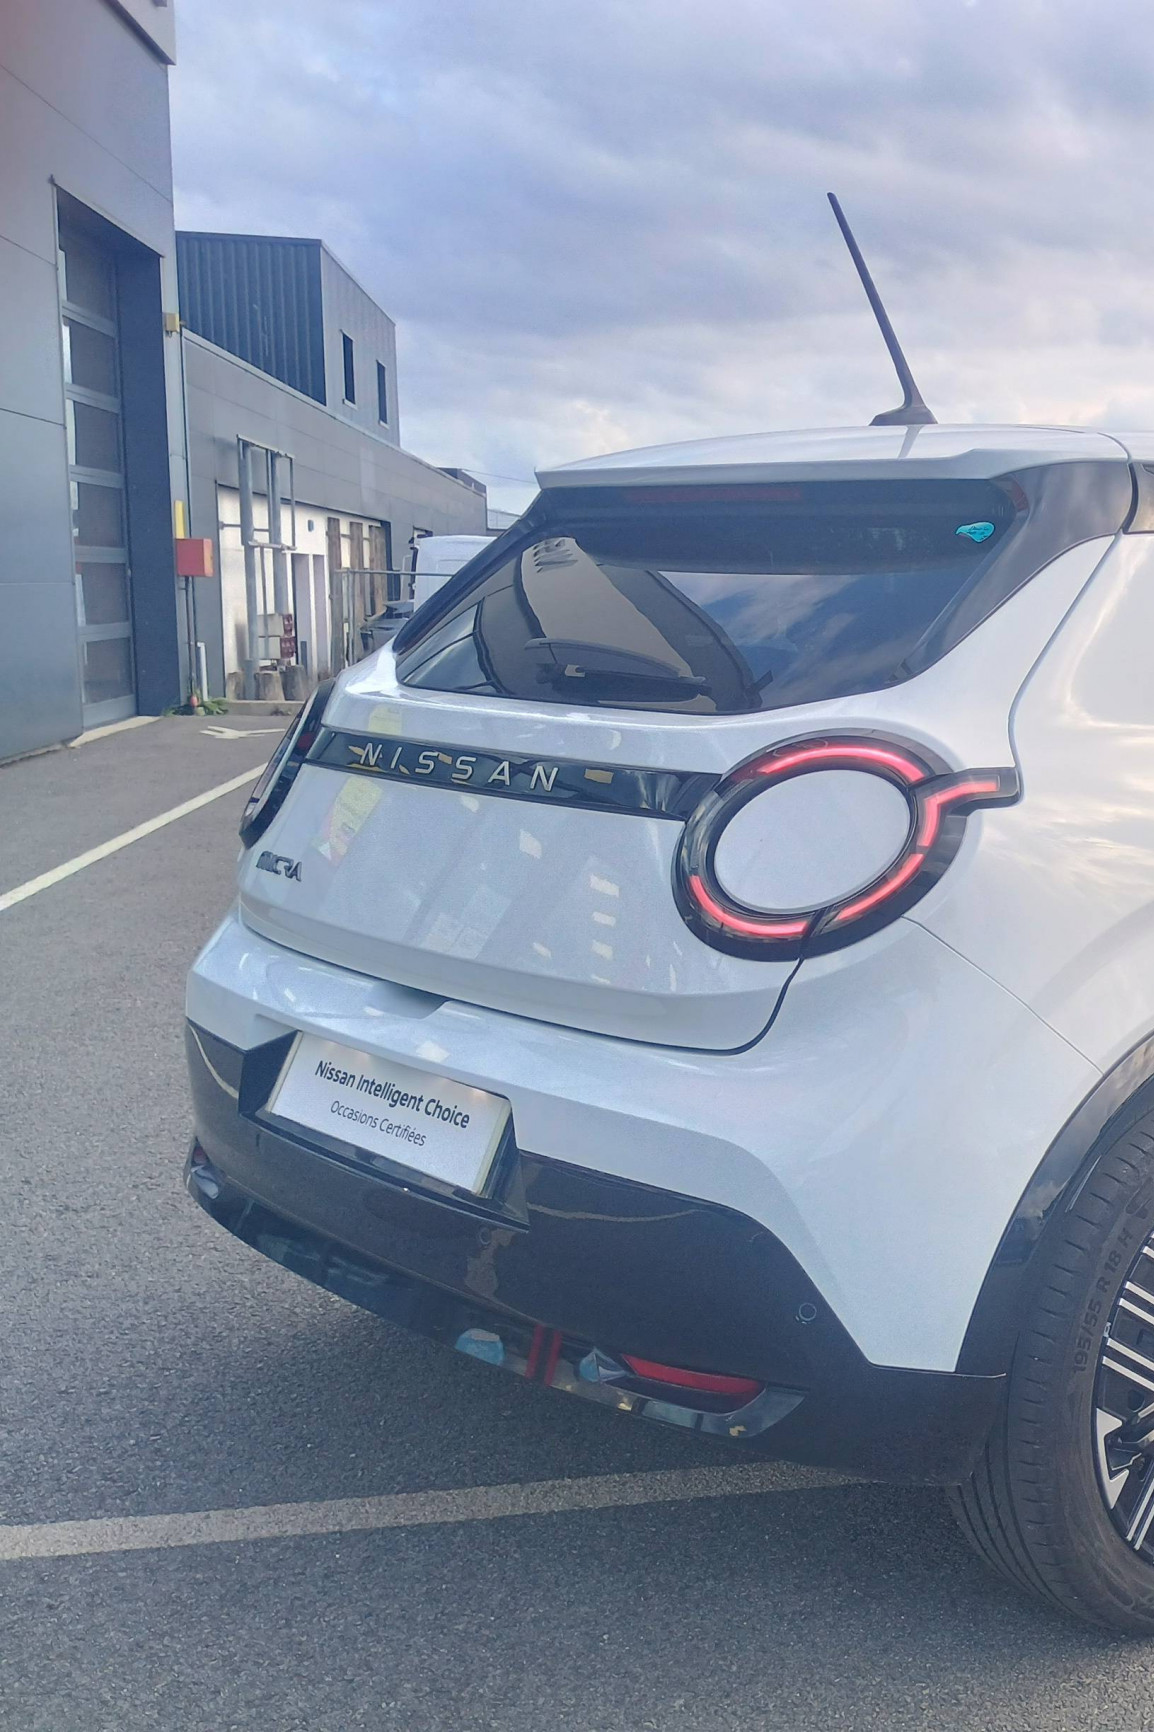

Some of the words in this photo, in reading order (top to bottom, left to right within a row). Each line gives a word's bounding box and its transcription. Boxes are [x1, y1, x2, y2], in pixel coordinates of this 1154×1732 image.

[362, 742, 559, 793] NISSAN
[315, 1060, 356, 1088] Nissan
[357, 1074, 424, 1112] Intelligent
[425, 1098, 470, 1128] Choice
[330, 1100, 378, 1128] Occasions
[379, 1118, 426, 1146] Certifiées
[1073, 1299, 1102, 1374] 195/55
[1096, 1276, 1111, 1293] R
[1104, 1250, 1122, 1272] 18
